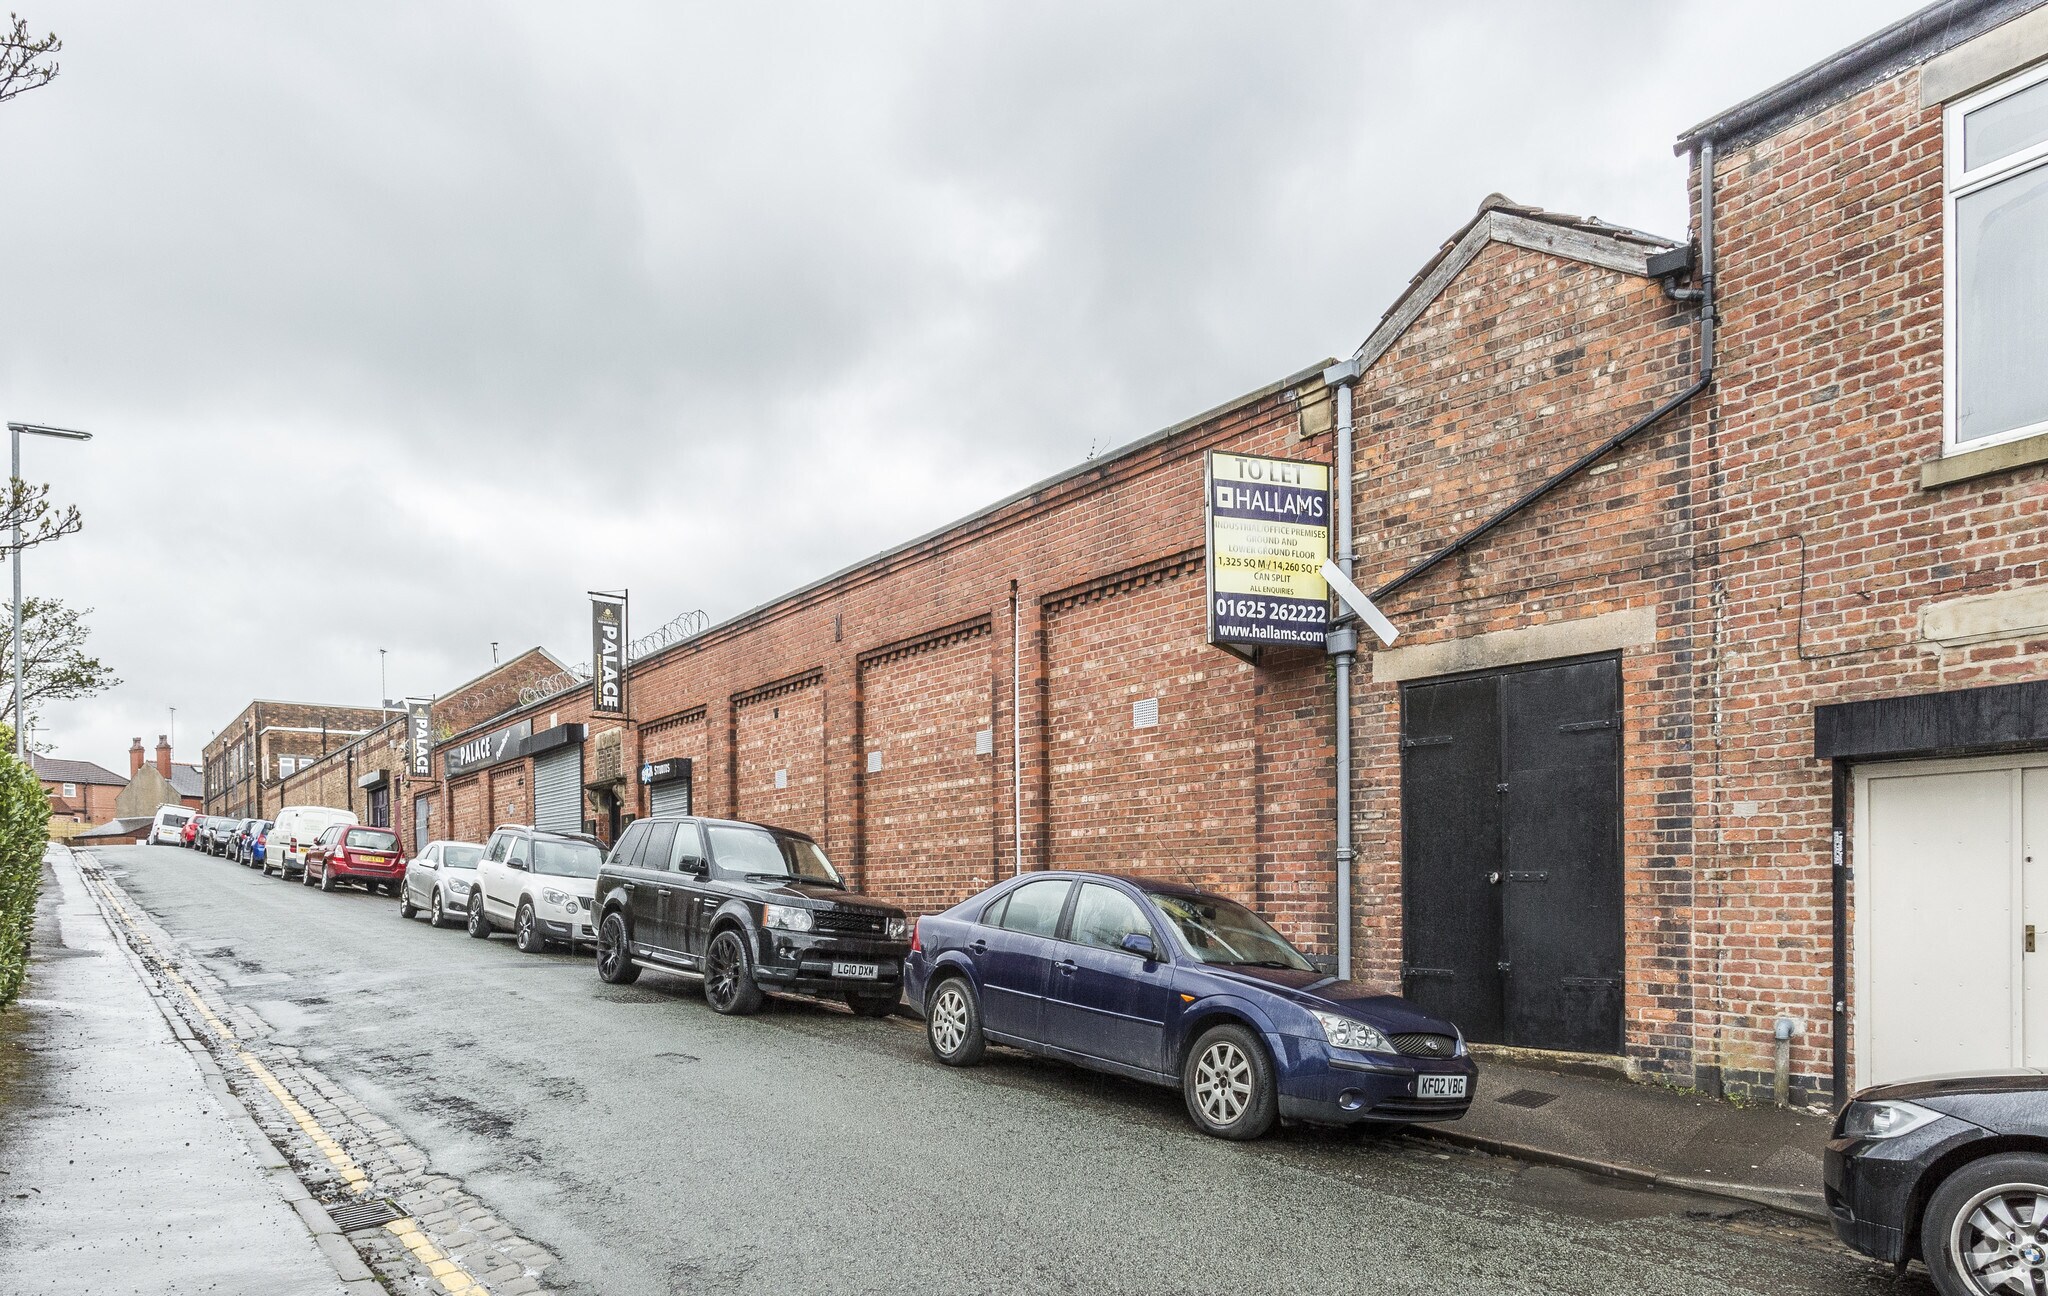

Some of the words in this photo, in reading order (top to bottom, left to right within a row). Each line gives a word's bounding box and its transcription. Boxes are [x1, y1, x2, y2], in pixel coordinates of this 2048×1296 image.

[1235, 458, 1263, 480] TO
[1269, 461, 1304, 485] LET
[1236, 488, 1323, 517] HALLAMS
[1215, 521, 1290, 535] INDUSTRIAL/OFFICE
[1291, 527, 1326, 539] PREMISES
[1247, 535, 1280, 545] GROUND
[1281, 538, 1298, 547] AND
[1228, 545, 1256, 554] LOWER
[1257, 547, 1290, 557] GROUND
[1291, 550, 1315, 559] FLOOR
[1218, 557, 1242, 567] 1,325
[1243, 559, 1256, 569] SQ
[1257, 560, 1266, 569] M
[1273, 561, 1300, 572] 14,260
[1301, 563, 1312, 574] SQ
[1254, 572, 1270, 581] CAN
[1271, 574, 1291, 583] SPLIT
[1250, 585, 1261, 593] ALL
[1262, 586, 1295, 596] ENQUIRIES
[1216, 598, 1266, 619] 01625
[1269, 602, 1326, 623] 262222
[1219, 624, 1324, 642] www.hallams.com
[602, 625, 618, 707] PALACE
[416, 719, 428, 774] PALACE
[460, 736, 492, 766] PALACE
[837, 963, 857, 975] LG10
[859, 965, 874, 976] DXM
[1421, 1078, 1445, 1094] KF02
[1447, 1078, 1464, 1094] VBG
